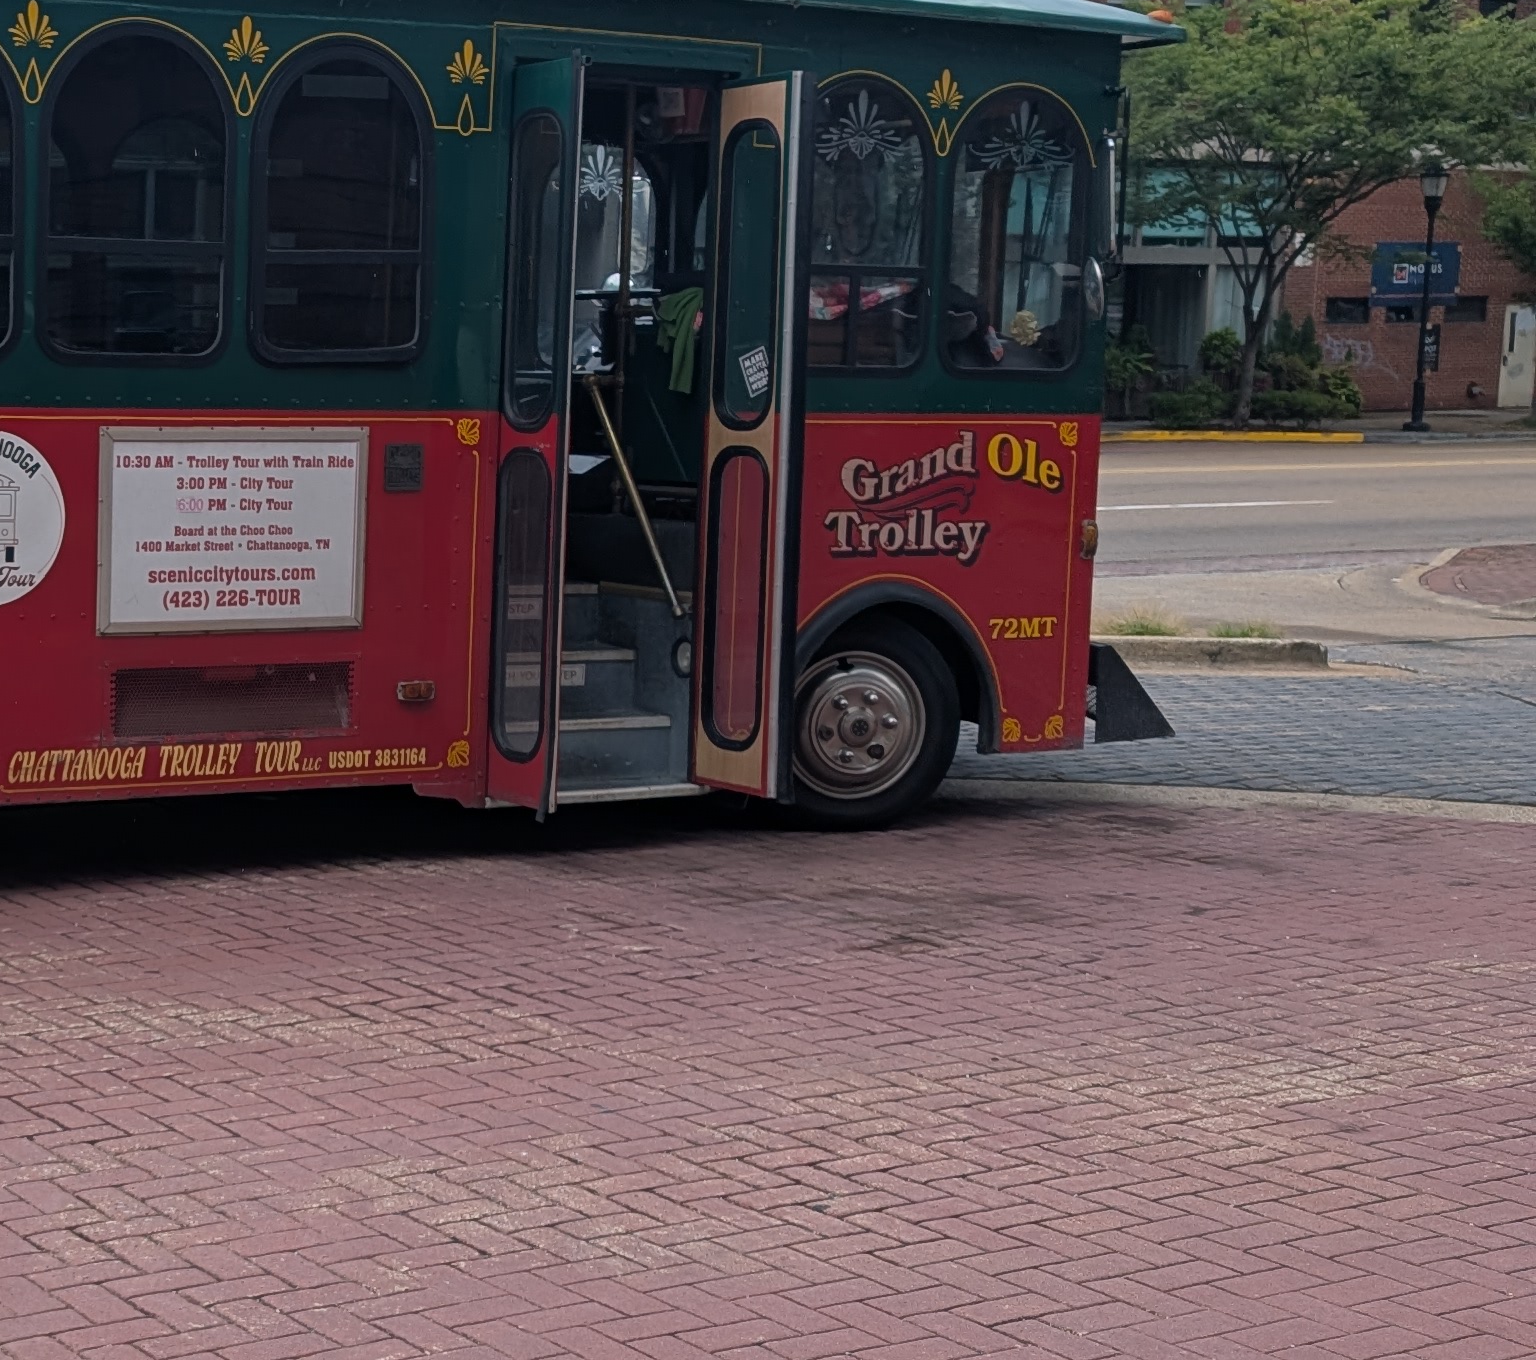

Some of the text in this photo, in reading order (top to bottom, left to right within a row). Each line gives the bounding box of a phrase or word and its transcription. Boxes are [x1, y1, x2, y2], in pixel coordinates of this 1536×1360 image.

[116, 456, 151, 468] 10:30
[155, 456, 173, 468] AM
[187, 456, 229, 470] Trolley
[233, 456, 260, 468] Tour
[263, 456, 289, 468] with
[293, 456, 323, 468] Train
[328, 456, 354, 468] Ride
[841, 431, 1061, 501] Grand Ole
[177, 477, 205, 490] 3:00
[209, 477, 227, 490] PM
[240, 478, 263, 492] City
[267, 478, 294, 489] Tour
[178, 499, 203, 511] 6:00
[208, 499, 226, 511] PM
[240, 499, 262, 513] City
[266, 499, 293, 511] Tour
[174, 525, 293, 537] Board at the Choo Choo
[824, 509, 986, 561] Trolley
[135, 539, 330, 553] 1400 Market Street Chattanooga, TN
[148, 566, 316, 585] sceniccitytours.com
[162, 589, 301, 611] (423) 226-TOUR
[989, 617, 1058, 639] 72MT
[8, 741, 426, 784] CHATTANOOGA TROLLEY TOUR LLC USDOT 3831164
